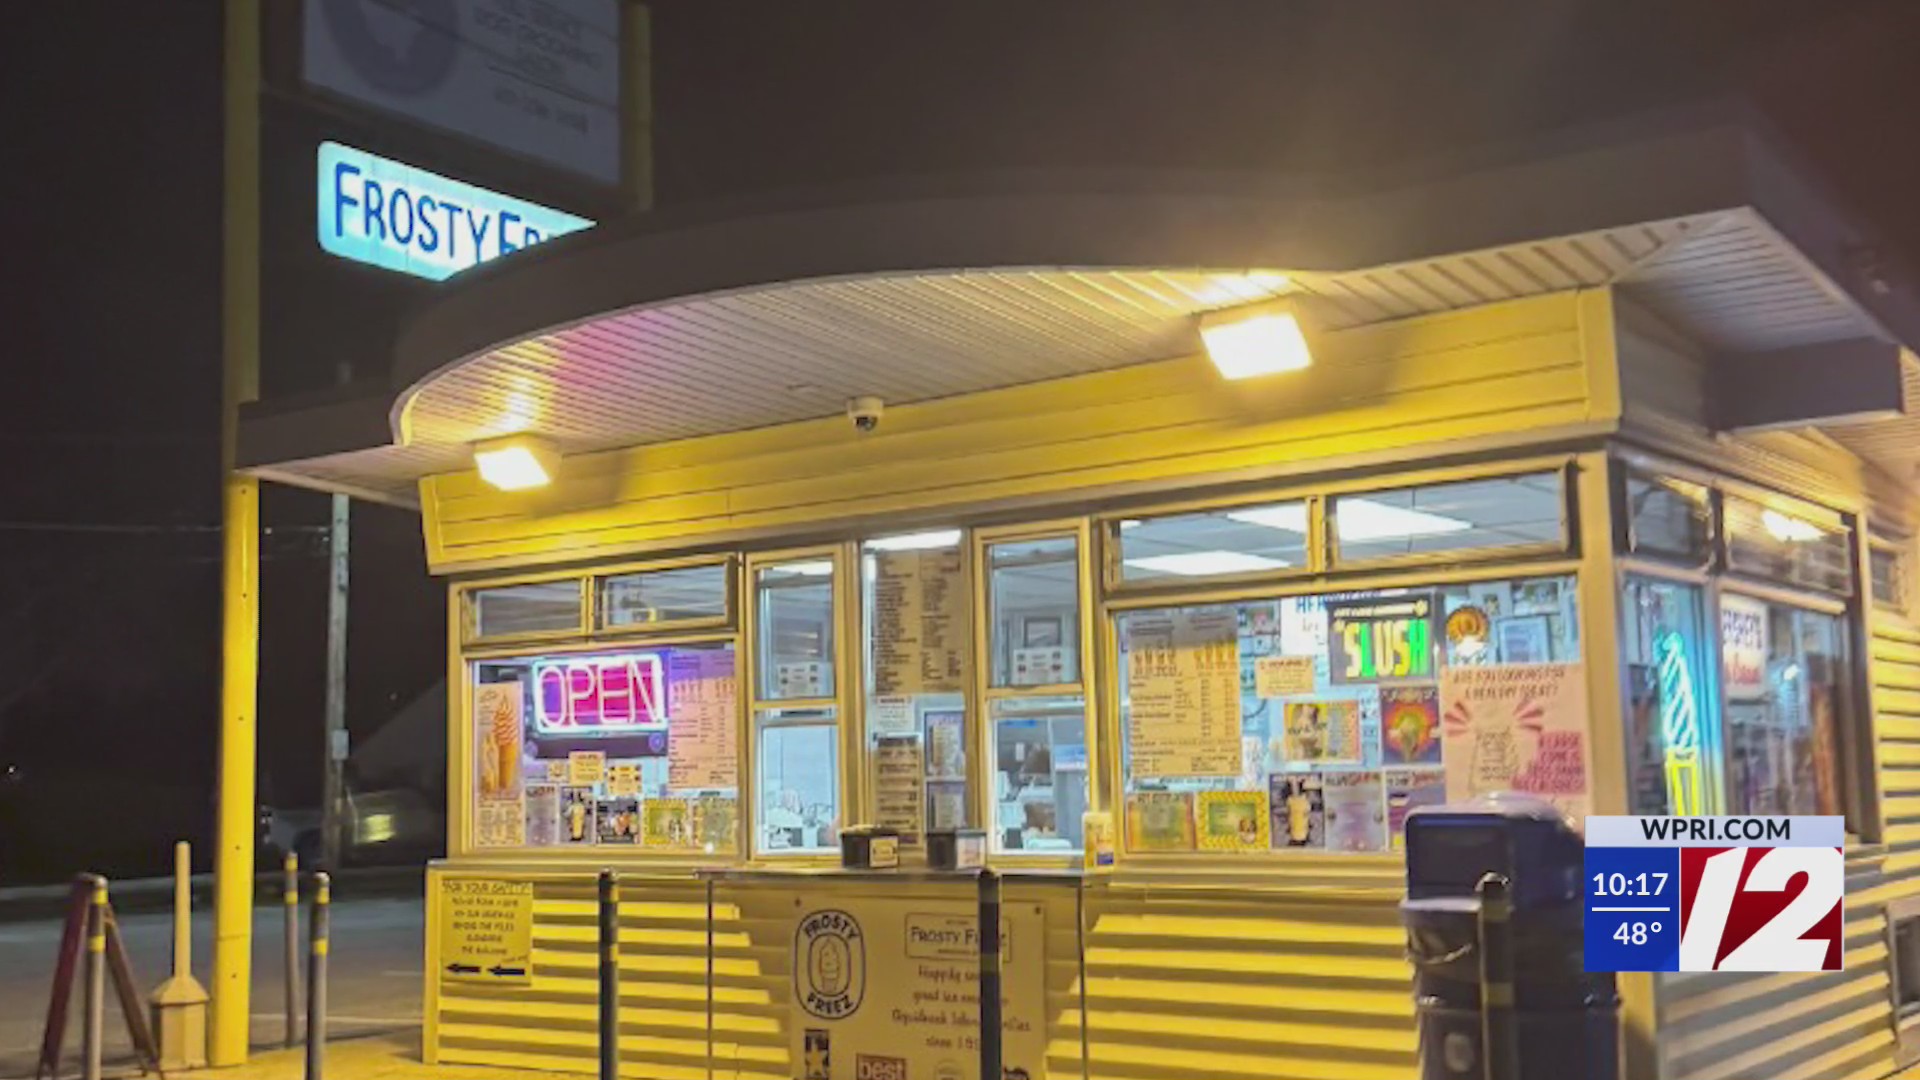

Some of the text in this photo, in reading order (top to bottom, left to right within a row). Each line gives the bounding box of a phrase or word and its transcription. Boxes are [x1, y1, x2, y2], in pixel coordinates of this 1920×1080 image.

[335, 162, 490, 264] FROSTY
[1344, 619, 1429, 678] SLUSH
[538, 660, 662, 728] OPEN
[804, 913, 860, 940] FROSTY
[910, 926, 960, 944] FROSTY
[807, 992, 854, 1014] FREEZ
